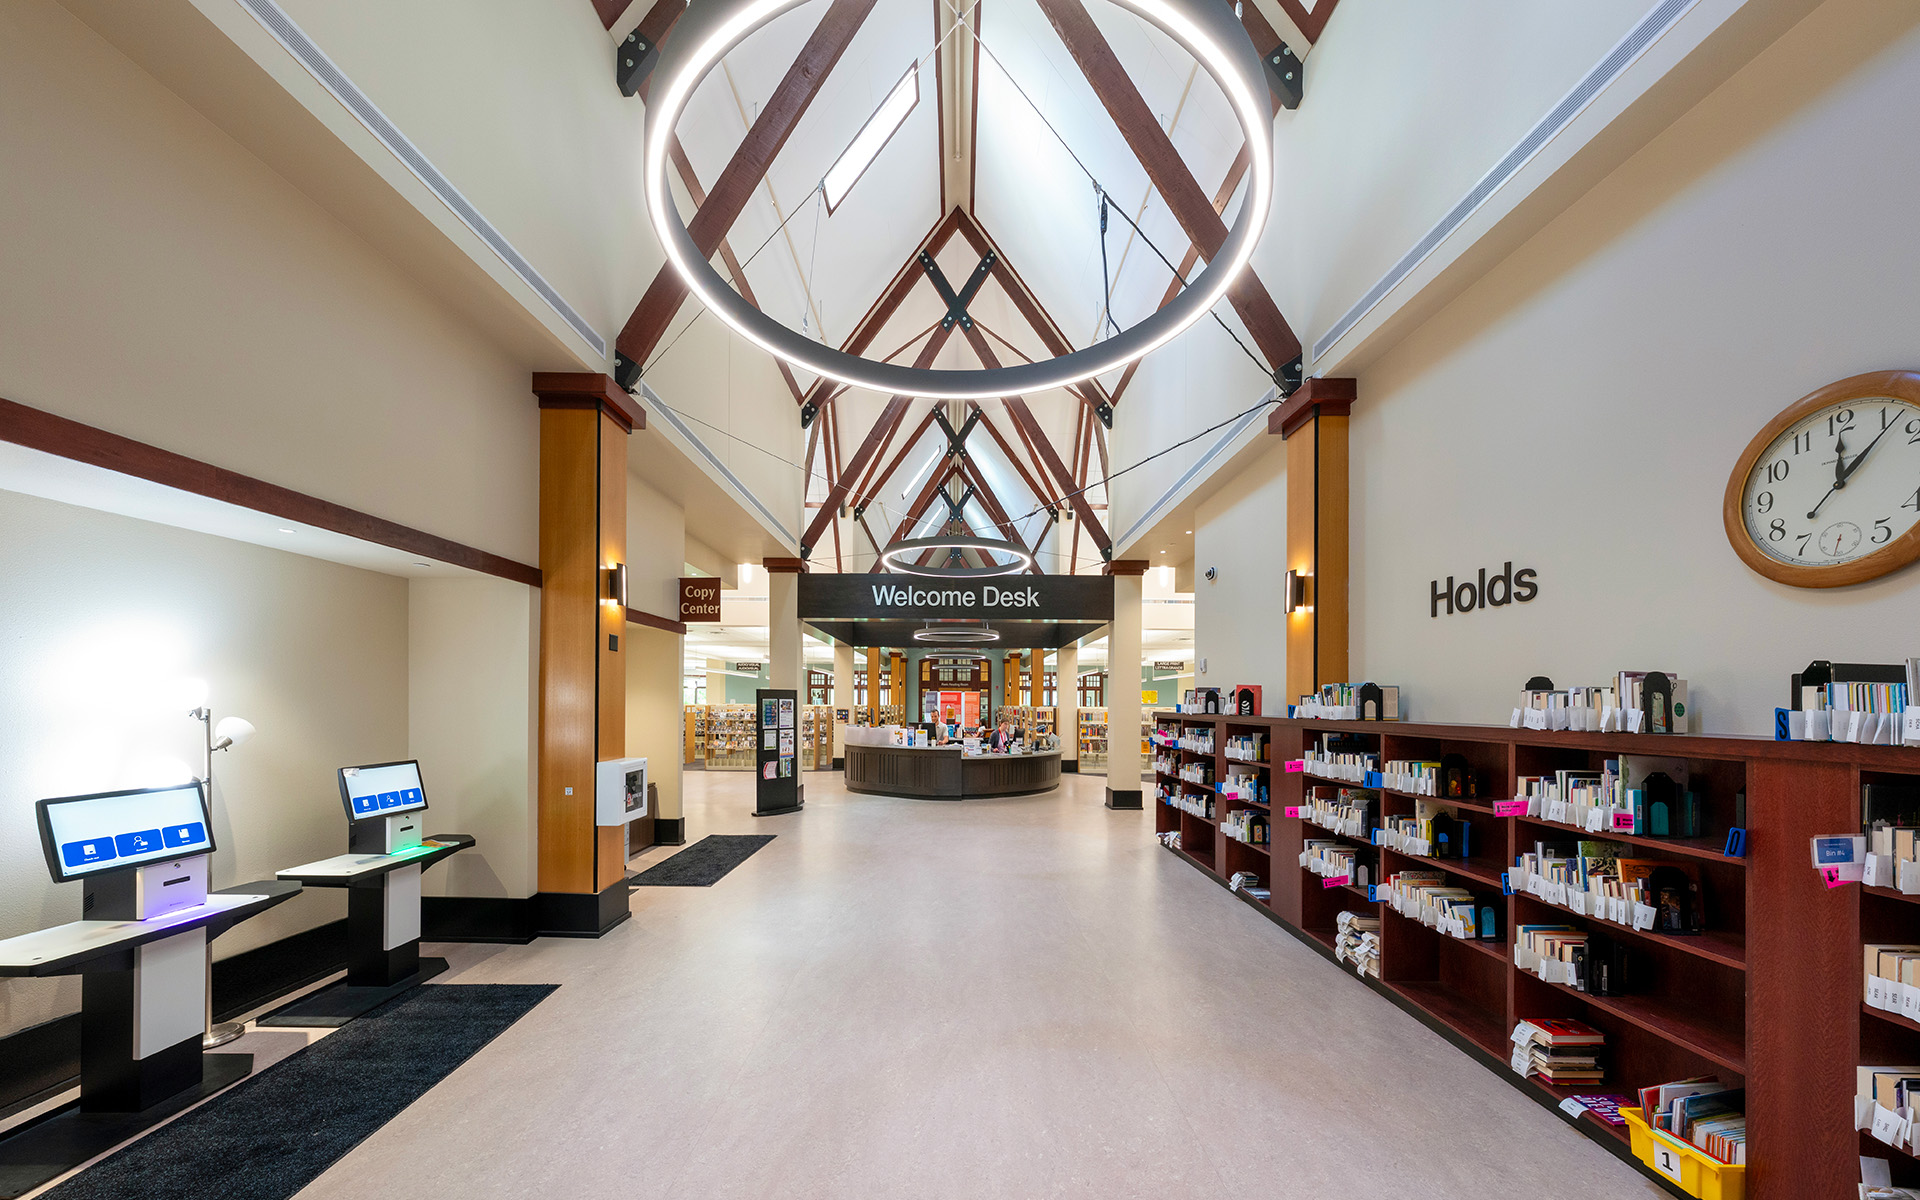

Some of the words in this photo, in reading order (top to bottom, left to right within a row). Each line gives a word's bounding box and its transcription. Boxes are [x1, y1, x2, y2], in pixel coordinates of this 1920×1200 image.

[1827, 409, 1856, 437] 12
[1879, 407, 1888, 431] 1
[1793, 431, 1811, 456] 11
[1766, 459, 1790, 484] 10
[1757, 491, 1774, 514] 9
[1769, 518, 1786, 542] 8
[1871, 517, 1892, 543] 5
[1795, 533, 1812, 557] 7
[685, 585, 715, 600] Copy
[872, 585, 976, 607] Welcome
[983, 586, 1040, 607] Desk
[1431, 561, 1538, 618] Holds
[681, 602, 720, 614] Center
[1777, 711, 1788, 739] S
[1367, 772, 1373, 787] N
[1370, 887, 1375, 900] P
[1661, 1152, 1673, 1172] 1
